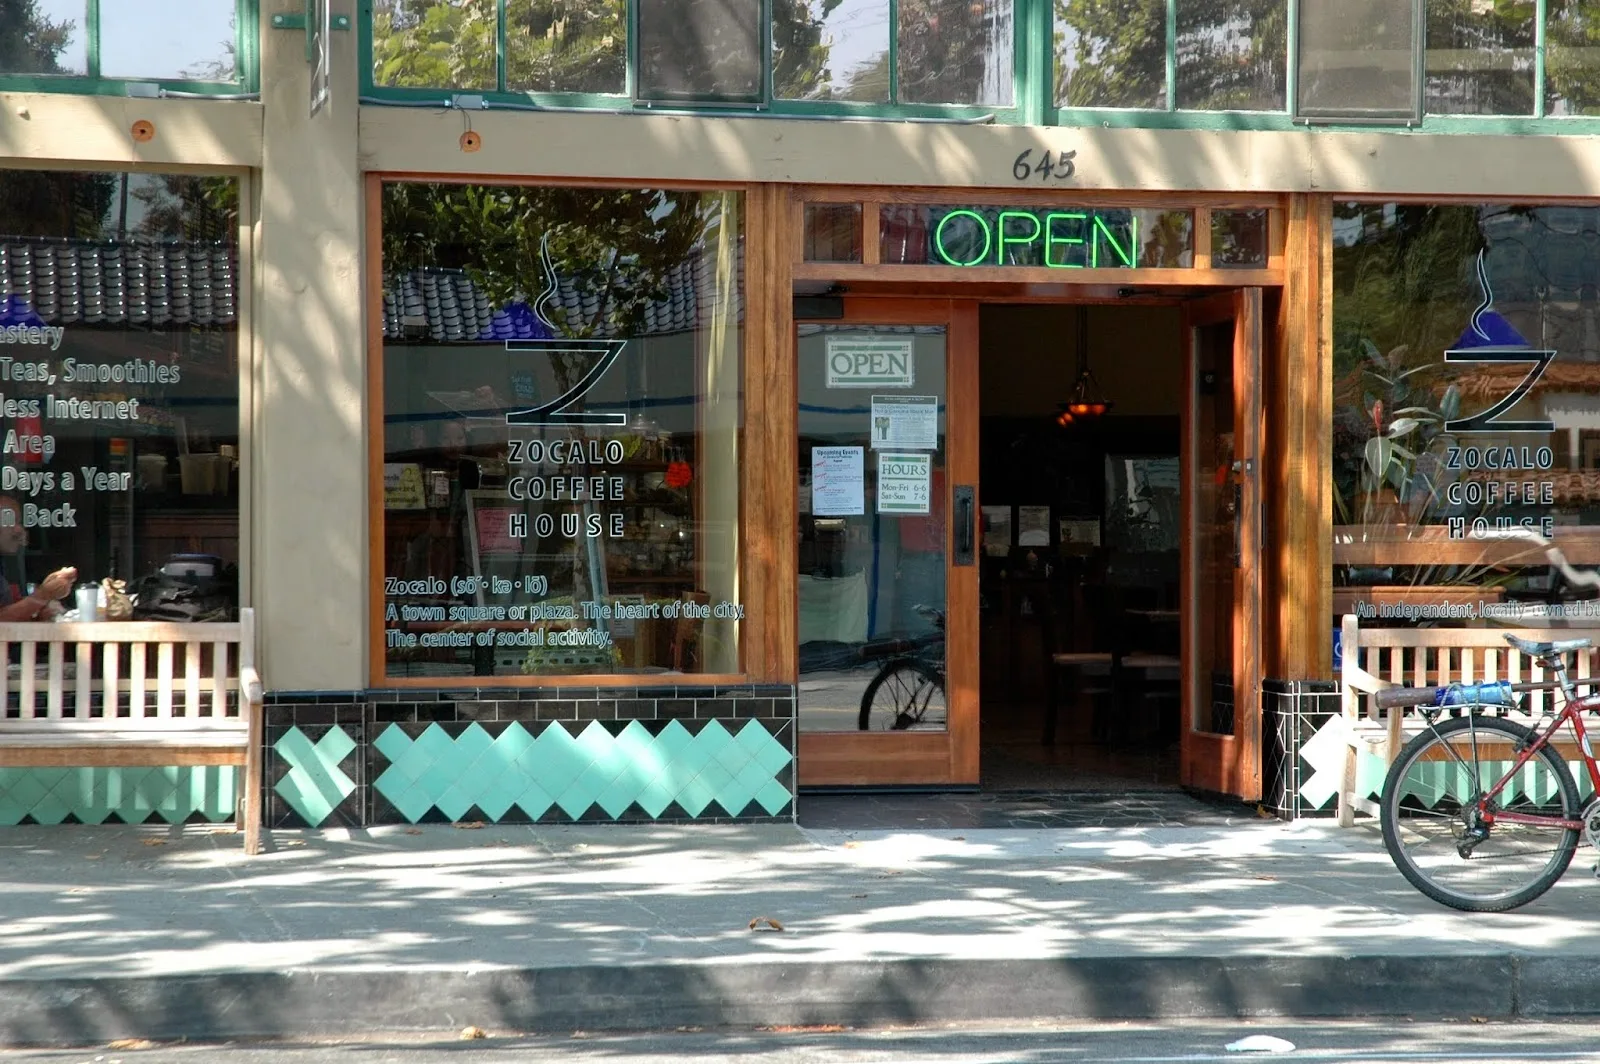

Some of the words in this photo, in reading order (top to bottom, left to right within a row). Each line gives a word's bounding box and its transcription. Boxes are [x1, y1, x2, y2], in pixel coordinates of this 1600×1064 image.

[1013, 149, 1076, 181] 645
[936, 210, 1137, 269] OPEN
[0, 357, 56, 385] Teas,
[63, 357, 181, 384] Smoothies
[830, 353, 909, 375] OPEN
[47, 394, 139, 419] Internet
[3, 429, 56, 454] Area
[507, 440, 624, 465] ZOCALO
[1447, 446, 1554, 469] ZOCALO
[2, 466, 55, 496] Days
[61, 472, 75, 491] a
[81, 466, 131, 491] Year
[882, 464, 927, 475] HOURS
[508, 477, 624, 500] COFFEE
[881, 483, 909, 491] Mon-Fri
[881, 492, 906, 500] Sat-Sun
[913, 492, 927, 500] 7-6
[1447, 481, 1554, 505] COFFEE
[23, 503, 77, 527] Back
[509, 514, 624, 538] HOUSE
[1448, 517, 1554, 540] HOUSE
[385, 575, 447, 595] Zocalo
[385, 603, 398, 621] A
[402, 604, 445, 621] town
[449, 605, 506, 623] square
[508, 605, 527, 620] or
[530, 602, 579, 623] plaza.
[580, 602, 612, 619] The
[614, 601, 660, 619] heart
[662, 600, 681, 619] of
[683, 601, 711, 619] the
[714, 601, 746, 621] city.
[1356, 600, 1377, 618] An
[1380, 600, 1477, 622] independent,
[1479, 600, 1581, 620] locally-owned
[386, 629, 416, 647] The
[420, 631, 474, 647] center
[476, 629, 494, 647] of
[497, 628, 544, 646] social
[547, 628, 613, 649] activity.
